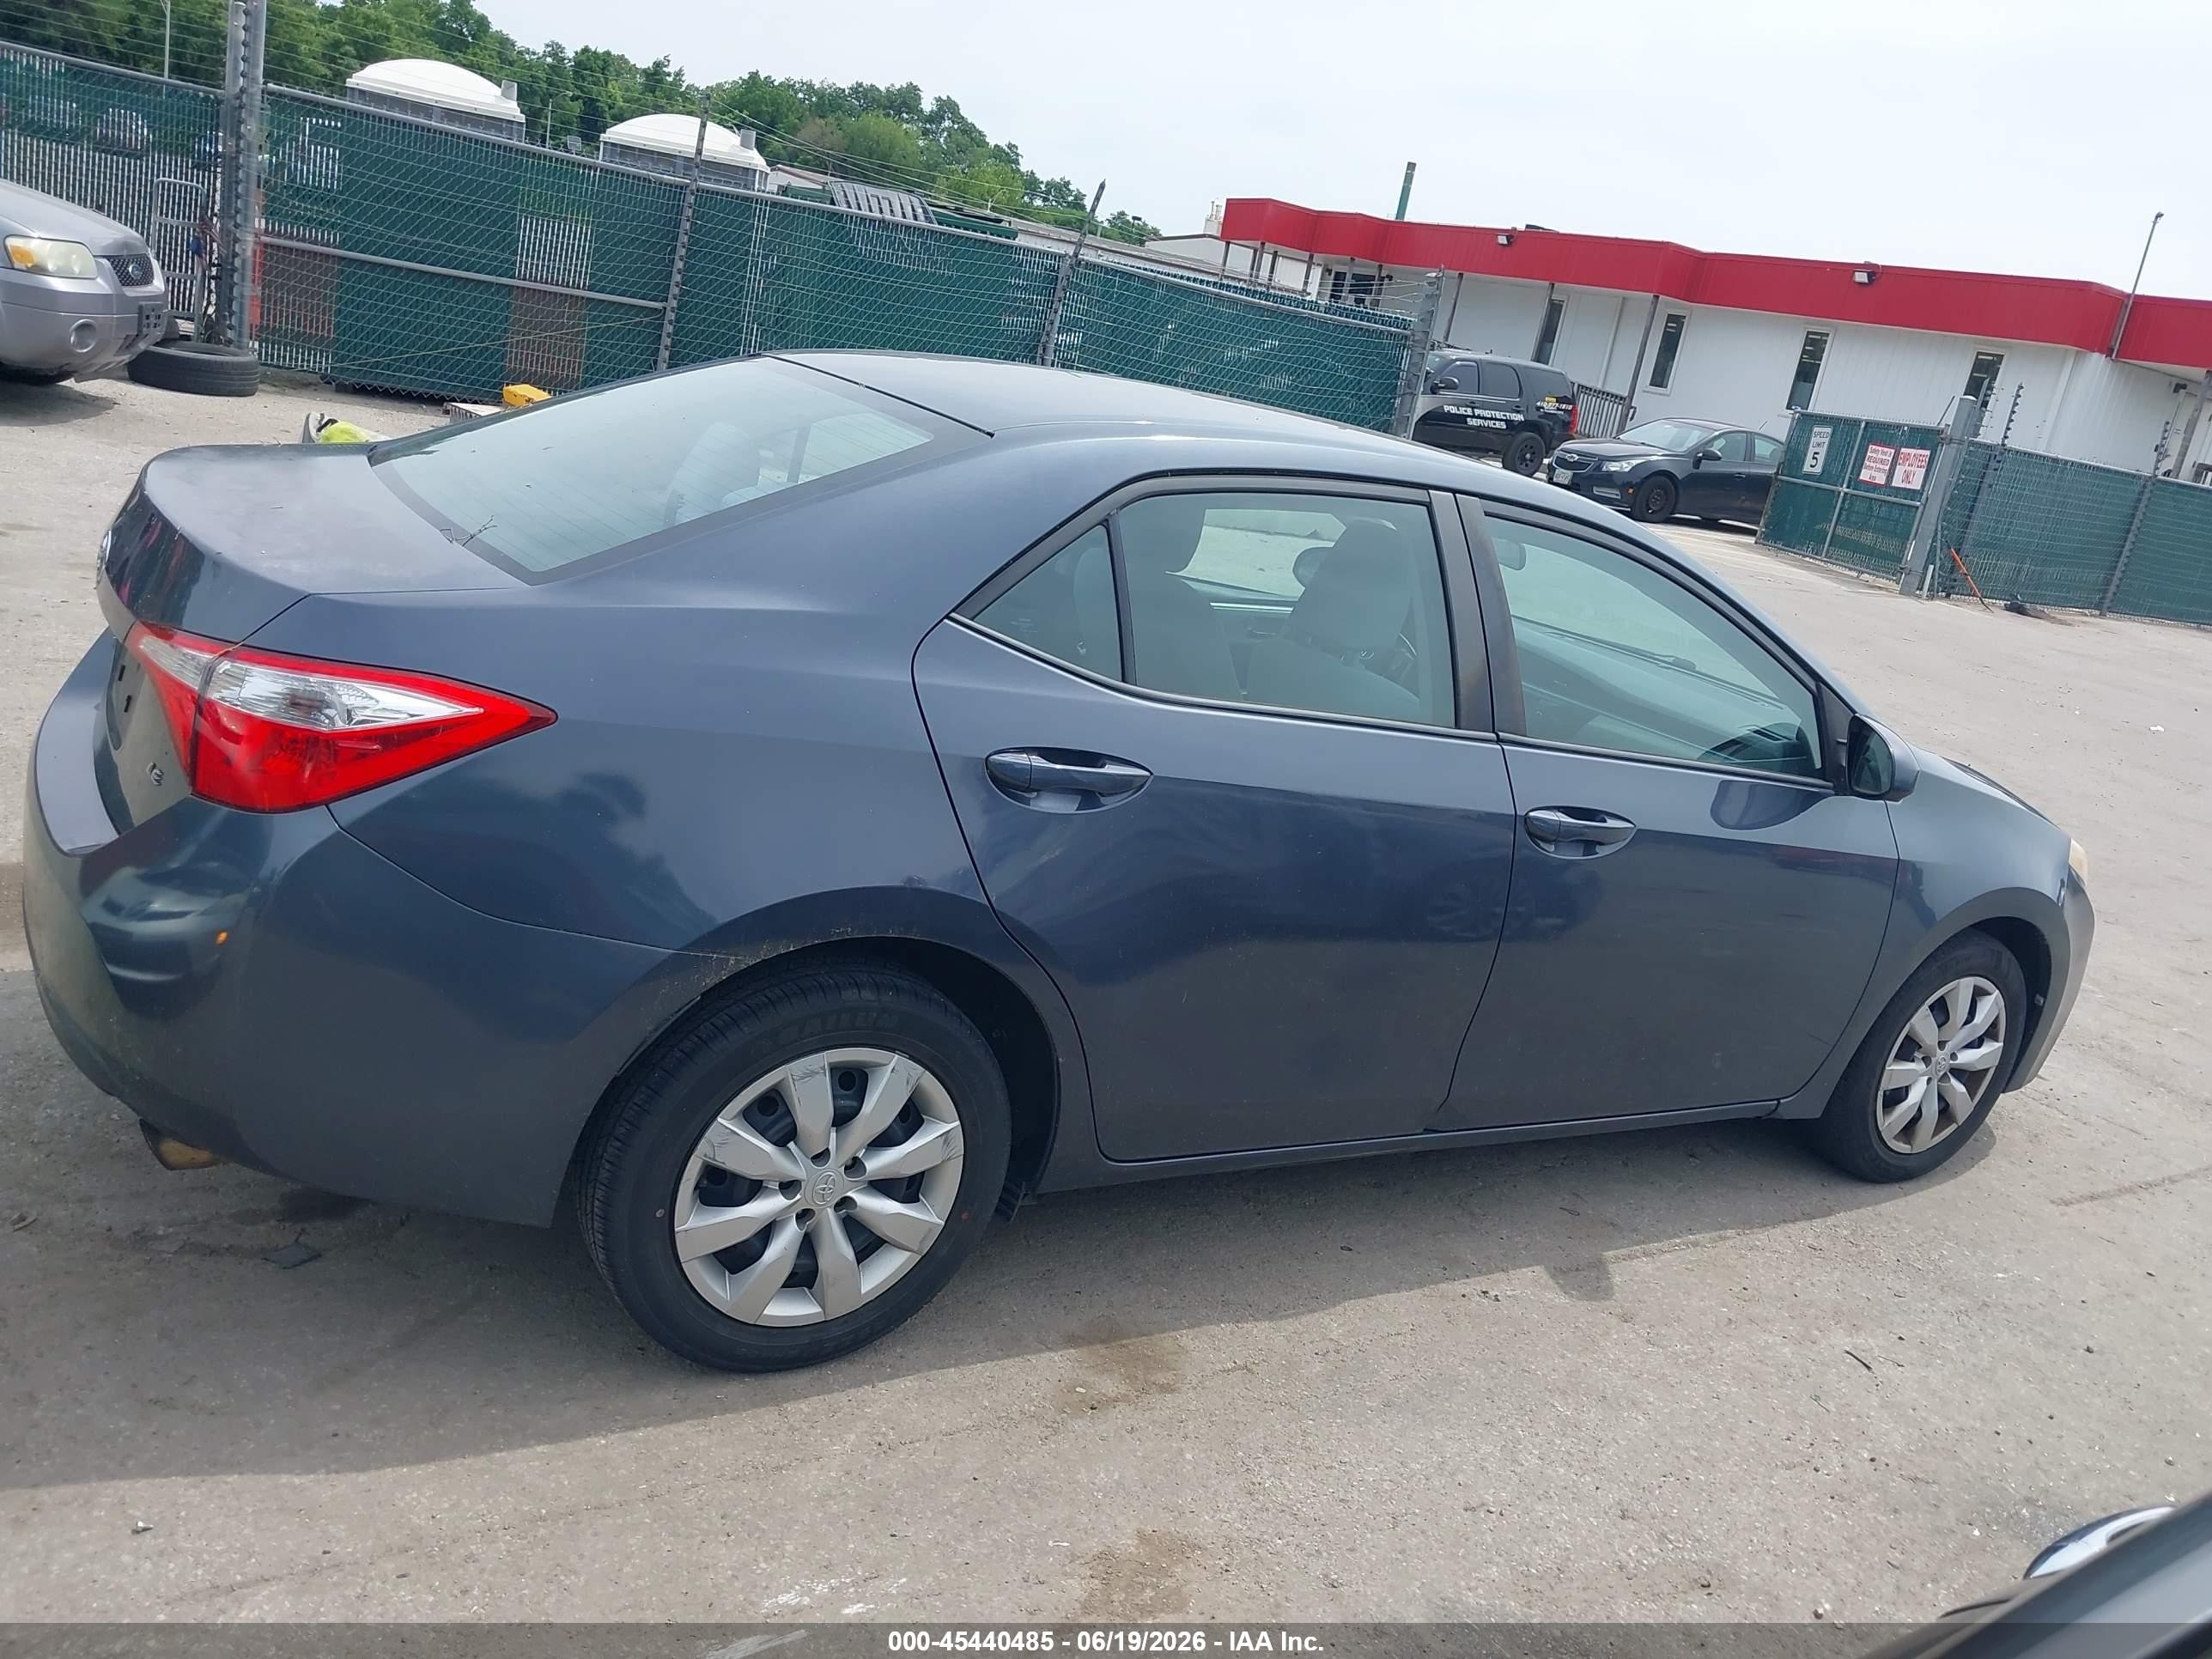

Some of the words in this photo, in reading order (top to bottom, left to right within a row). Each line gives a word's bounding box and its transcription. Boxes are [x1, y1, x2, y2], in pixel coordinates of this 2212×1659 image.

[1443, 404, 1474, 416] POLICE
[1474, 408, 1525, 422] PROTECTION
[1466, 417, 1506, 429] SERVICES
[1809, 451, 1820, 468] 5
[1866, 455, 1890, 466] REQUIRED
[1898, 452, 1929, 469] EMPLOYEES
[1901, 469, 1917, 484] ONLY
